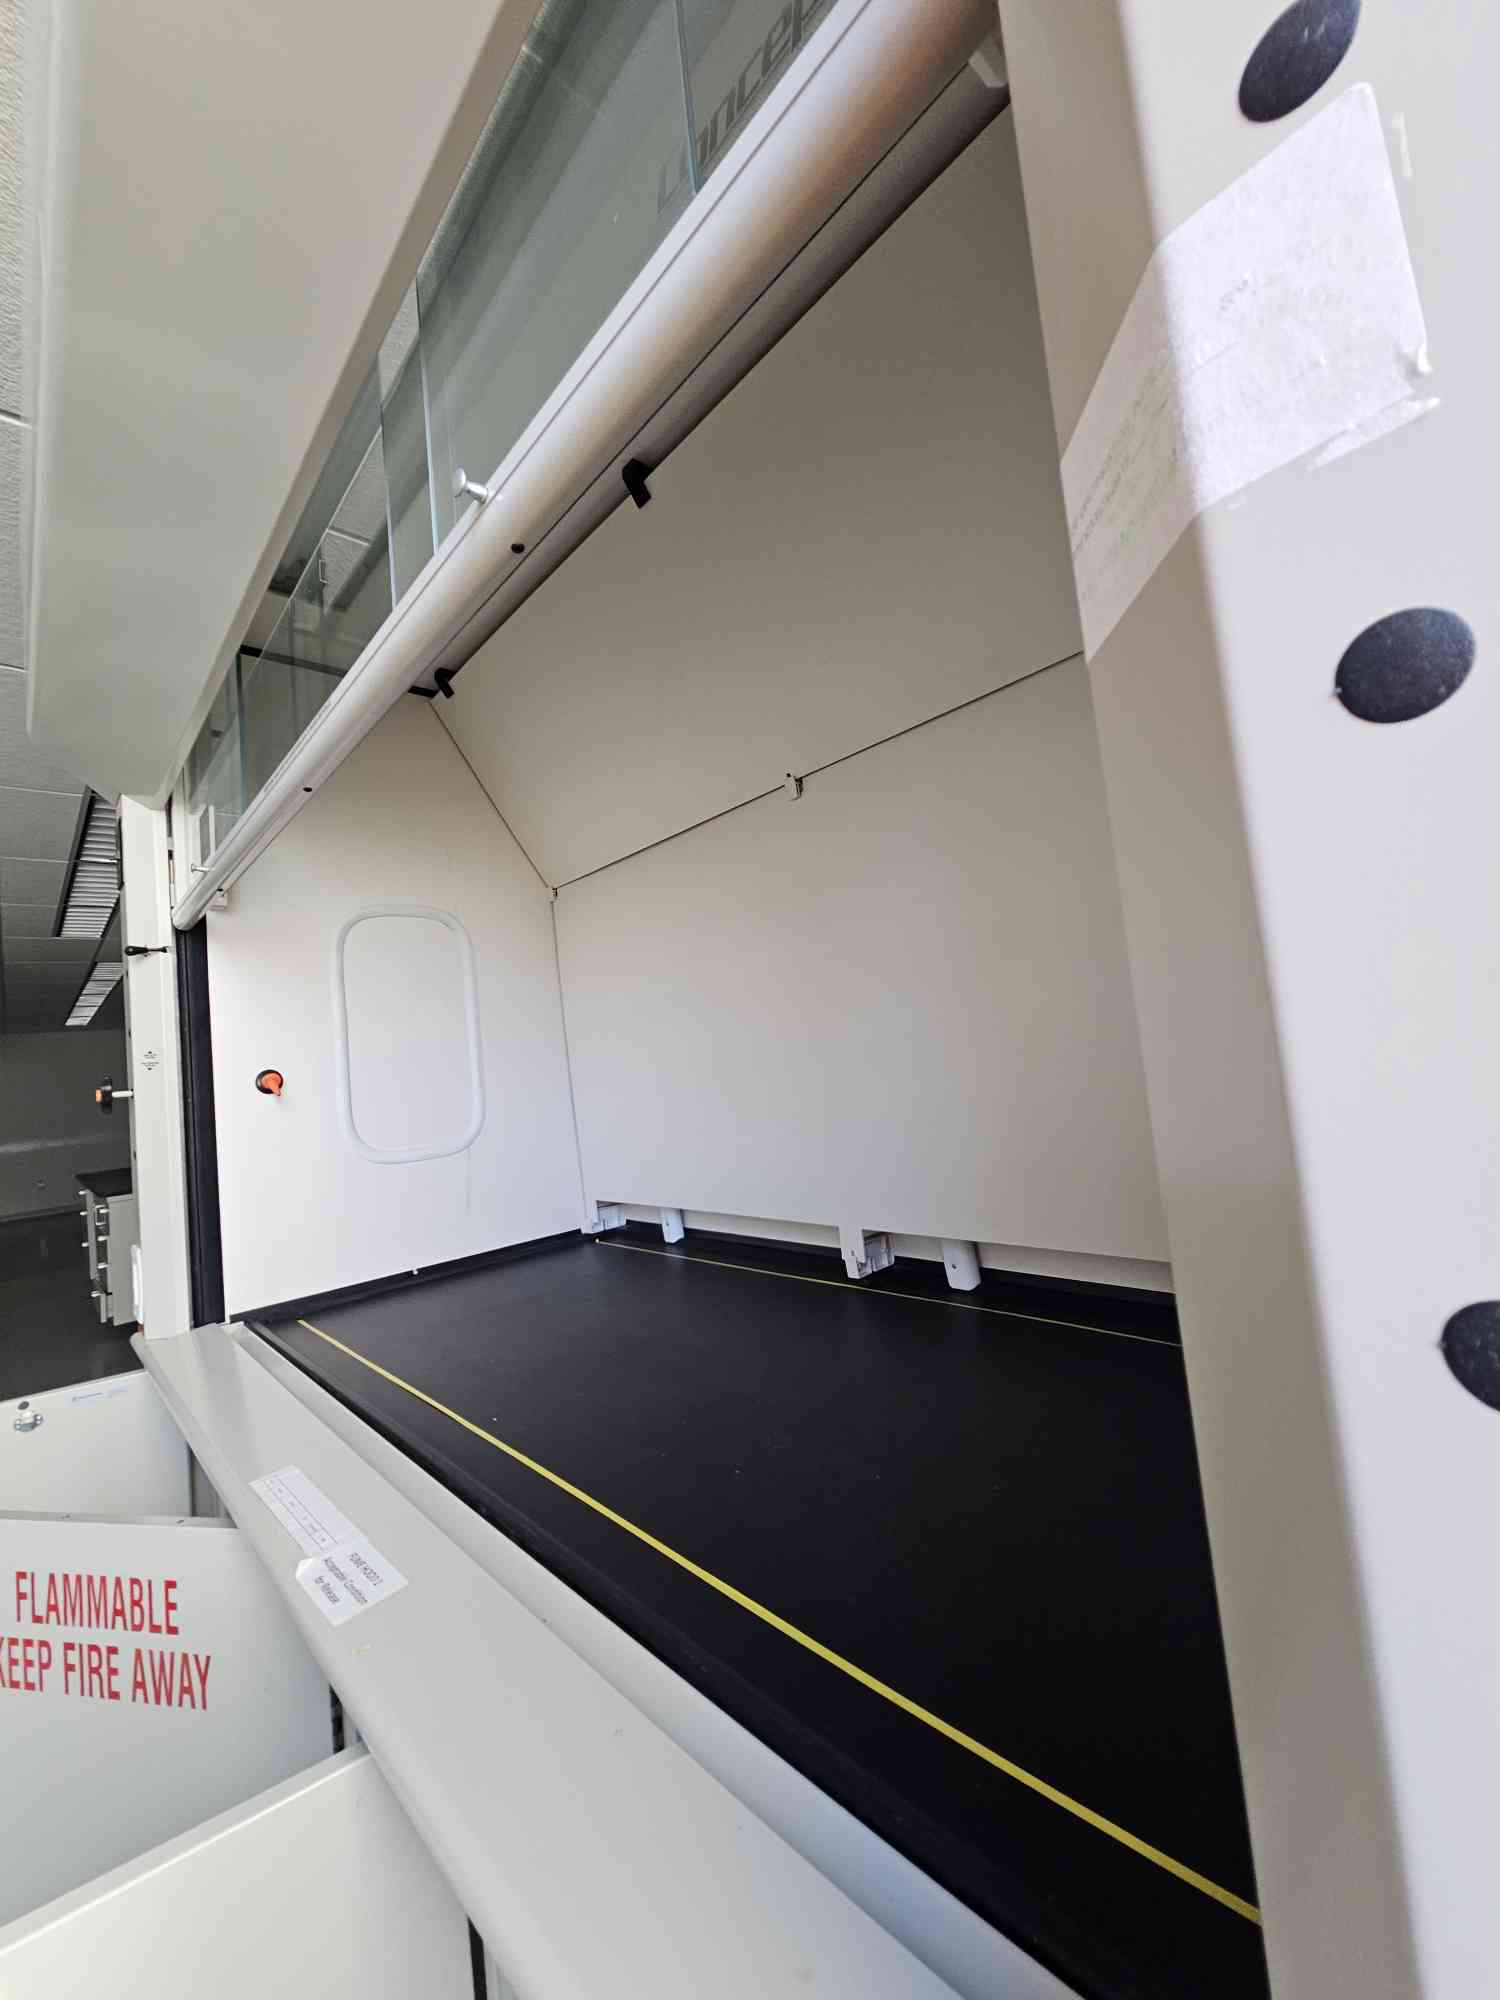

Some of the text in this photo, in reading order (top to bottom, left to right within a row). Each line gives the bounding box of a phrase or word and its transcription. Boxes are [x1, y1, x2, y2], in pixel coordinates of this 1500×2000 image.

[16, 1571, 178, 1635] FLAMMABLE
[63, 1642, 120, 1701] FIRE
[132, 1648, 211, 1711] AWAY
